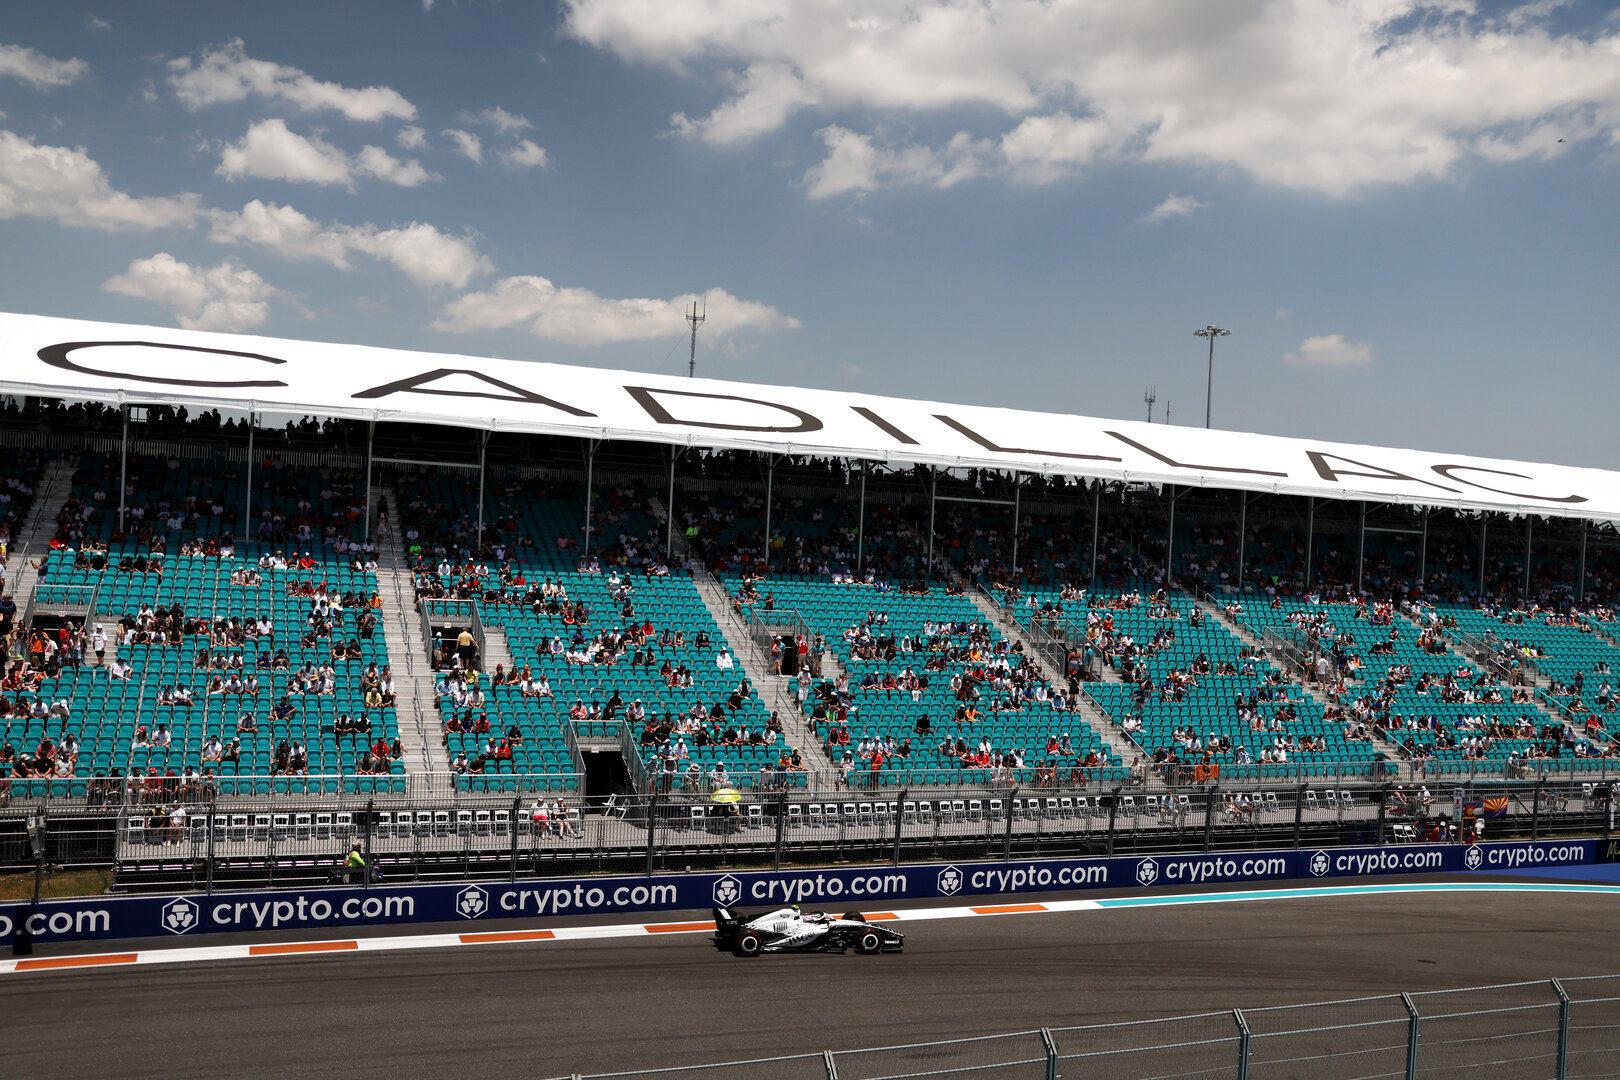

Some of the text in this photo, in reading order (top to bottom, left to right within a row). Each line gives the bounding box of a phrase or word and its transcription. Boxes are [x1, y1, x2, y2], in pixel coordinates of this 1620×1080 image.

[38, 341, 1588, 503] CADILLAC
[1165, 857, 1286, 882] crypto.com
[1336, 851, 1443, 874] crypto.com
[1488, 845, 1584, 867] crypto.com
[751, 874, 907, 902] crypto.com
[971, 864, 1108, 892] crypto.com
[213, 895, 415, 927] crypto.com
[500, 882, 677, 914] crypto.com
